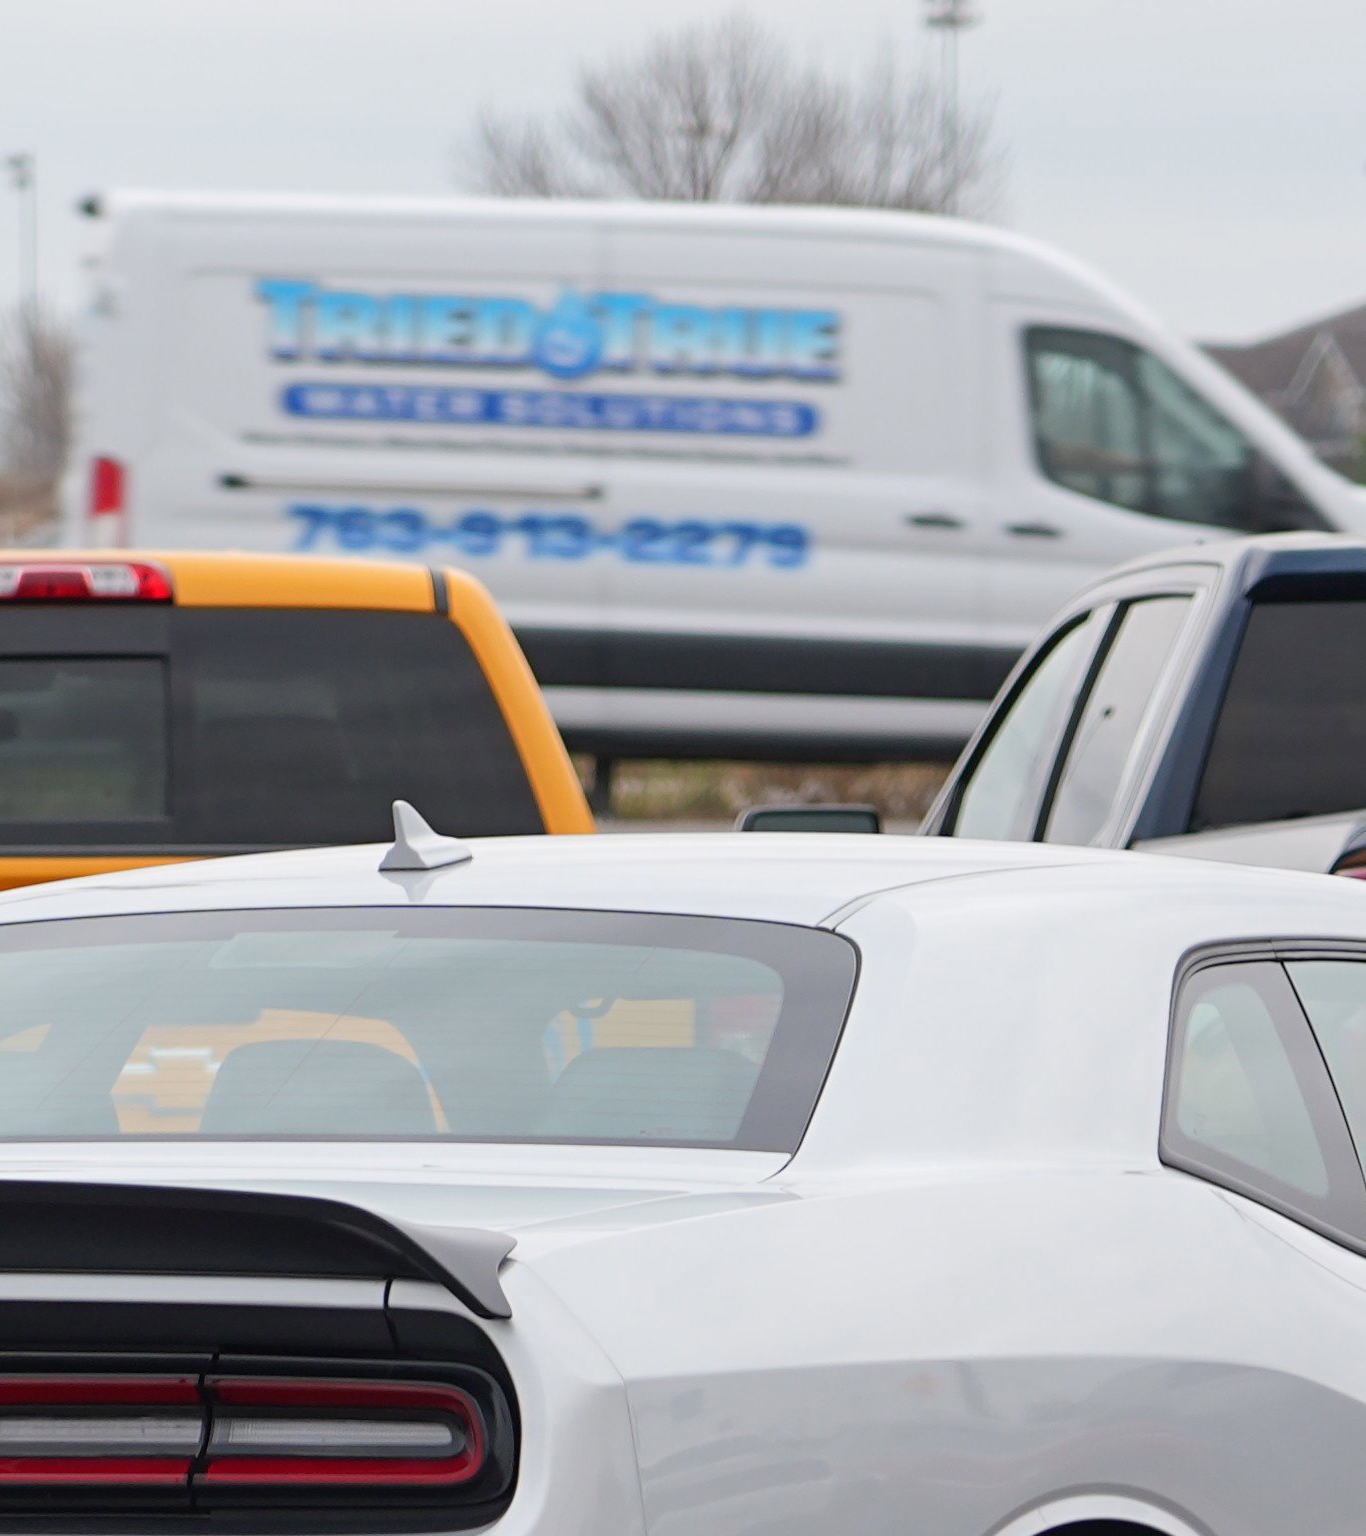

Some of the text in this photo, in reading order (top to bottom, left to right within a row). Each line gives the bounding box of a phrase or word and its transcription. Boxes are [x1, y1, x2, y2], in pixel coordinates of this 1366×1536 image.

[258, 280, 533, 366] TRIED
[592, 293, 839, 383] TRUE
[287, 505, 808, 569] 763-913-2279
